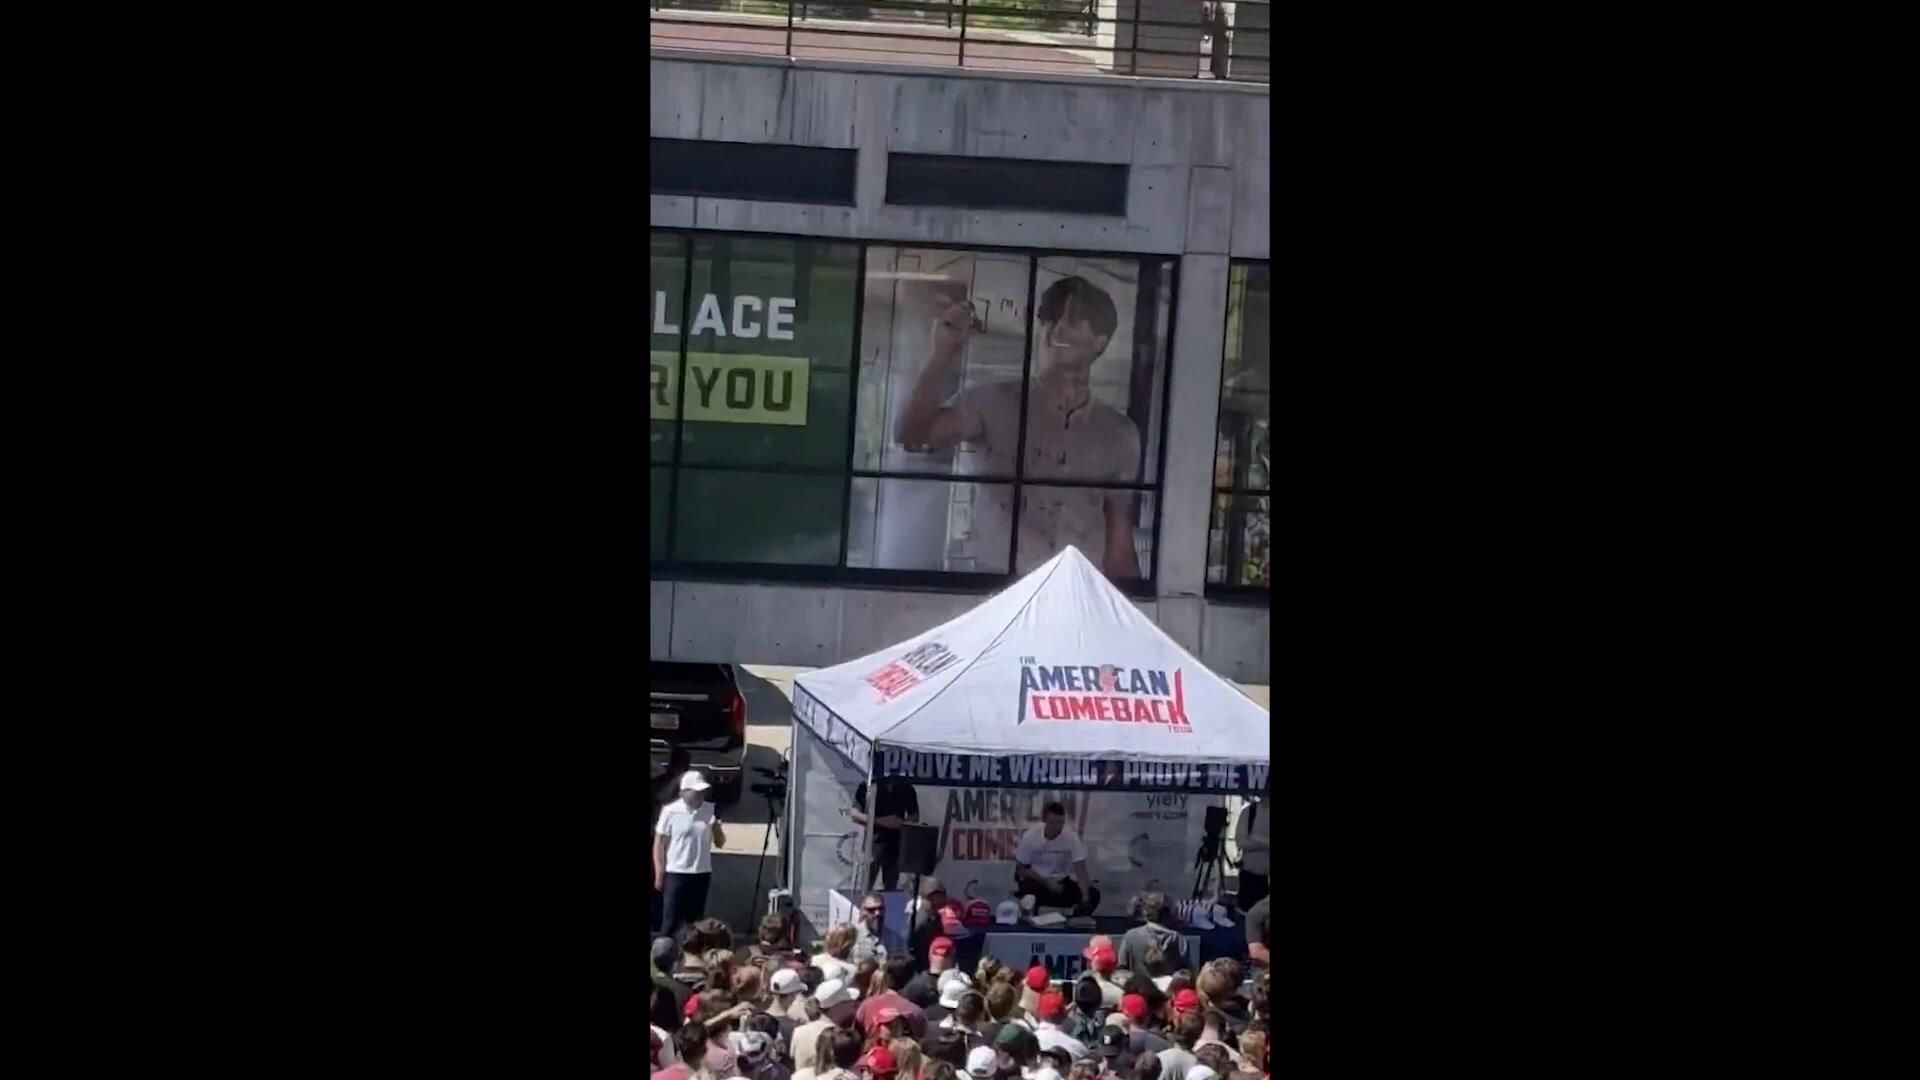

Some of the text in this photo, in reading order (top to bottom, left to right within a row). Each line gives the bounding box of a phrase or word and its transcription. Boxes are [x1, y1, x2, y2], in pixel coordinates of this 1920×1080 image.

[653, 290, 797, 341] LACE
[691, 365, 793, 412] YOU
[1032, 668, 1190, 726] COMEBACK
[883, 750, 1098, 785] PROVE ME WRONG
[1206, 763, 1240, 789] ME
